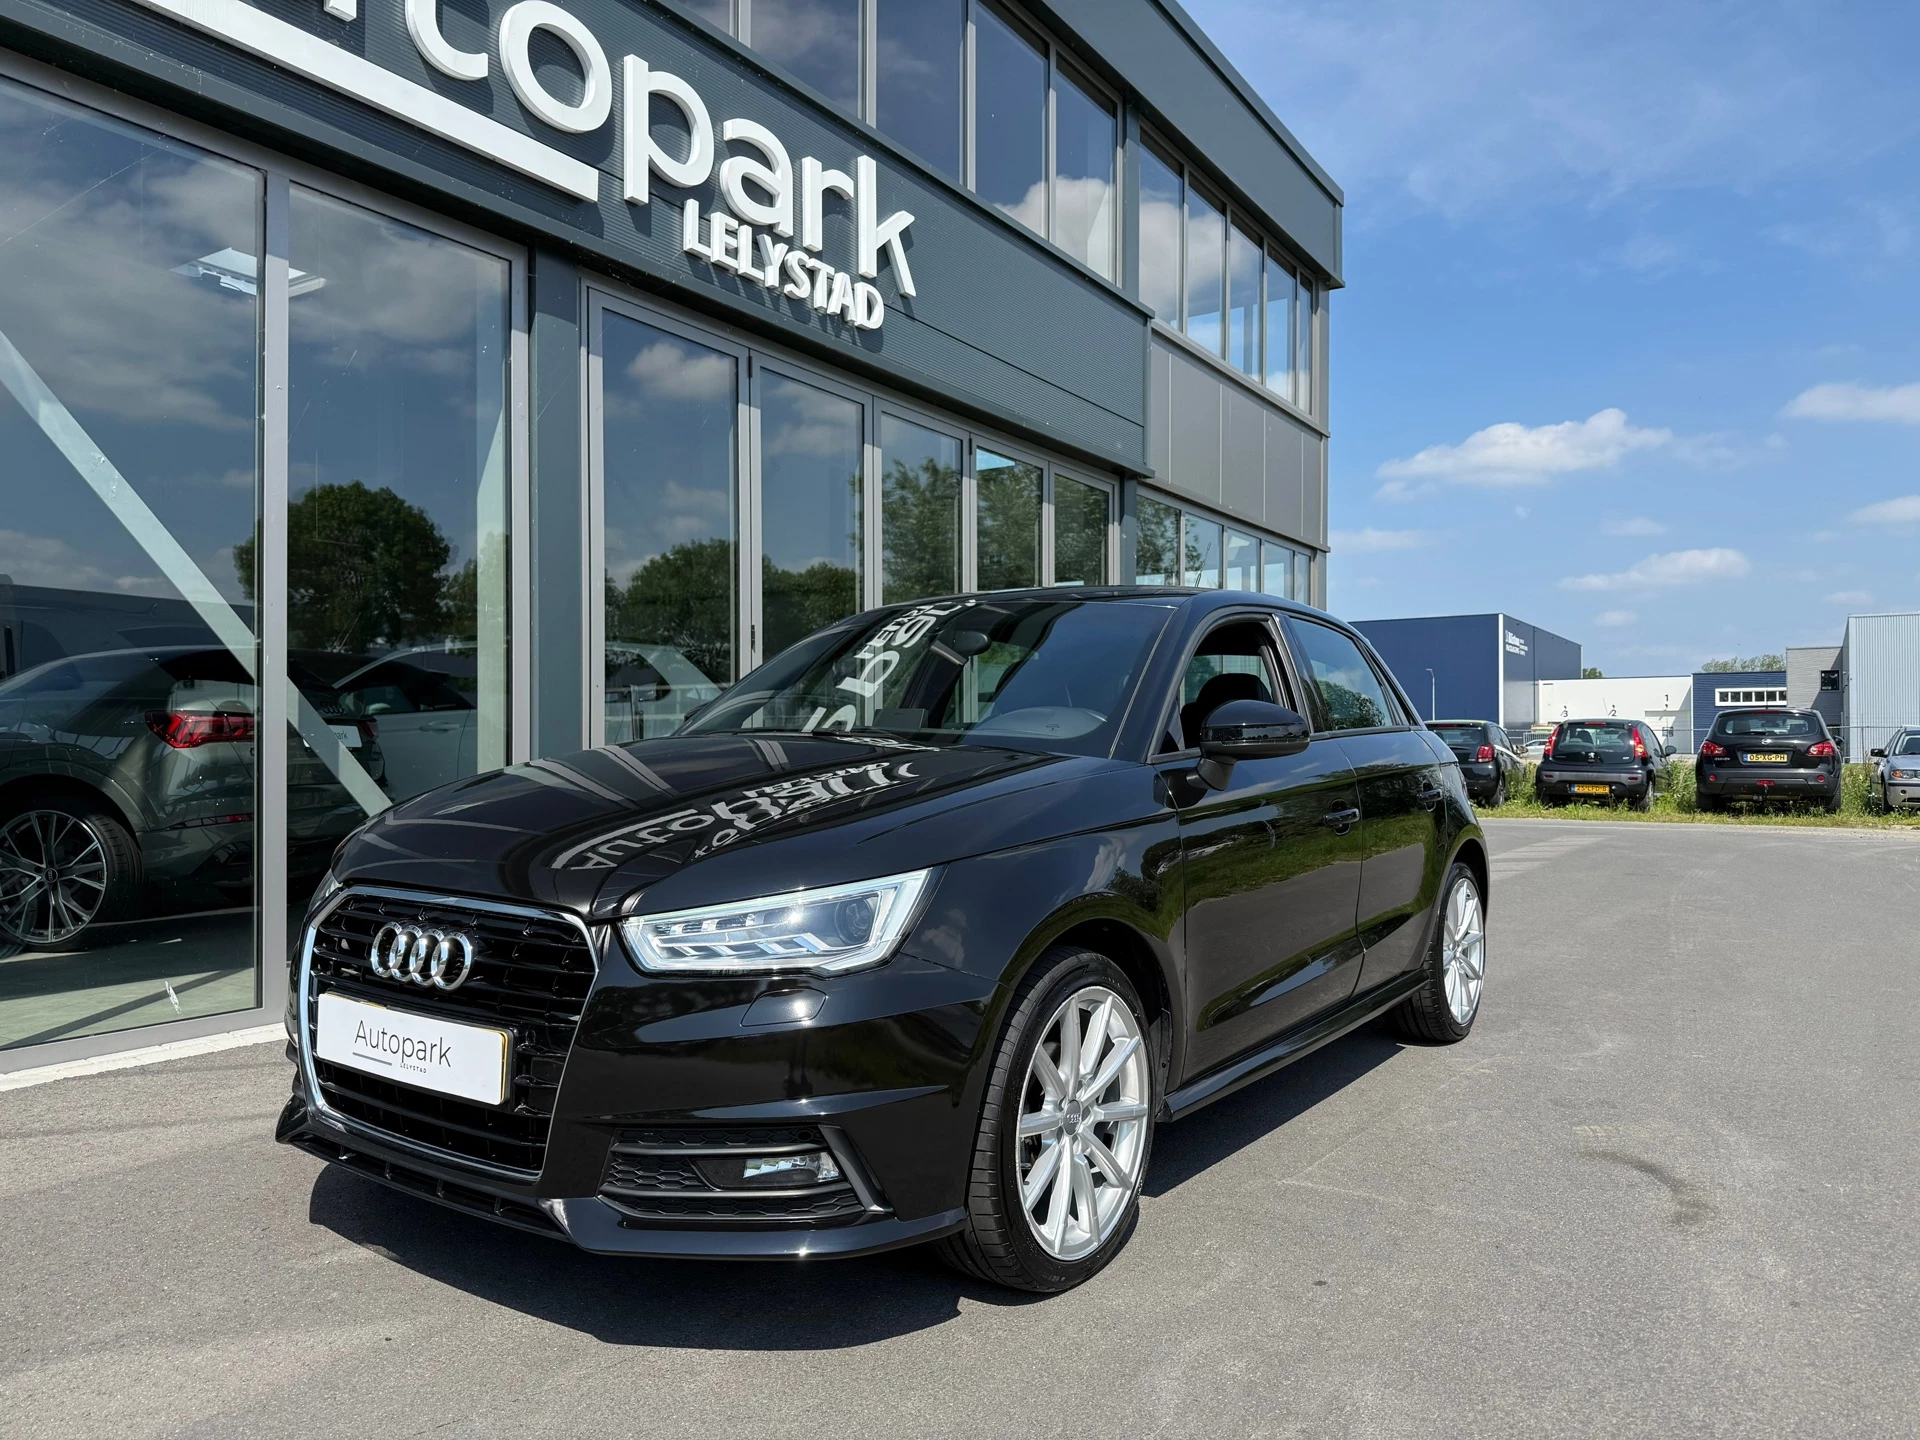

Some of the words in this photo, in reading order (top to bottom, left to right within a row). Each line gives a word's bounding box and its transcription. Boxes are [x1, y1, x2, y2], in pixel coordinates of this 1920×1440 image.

[684, 198, 885, 330] LELYSTAD
[354, 1019, 452, 1068] Autopark
[400, 1063, 427, 1074] LELYSTAD
